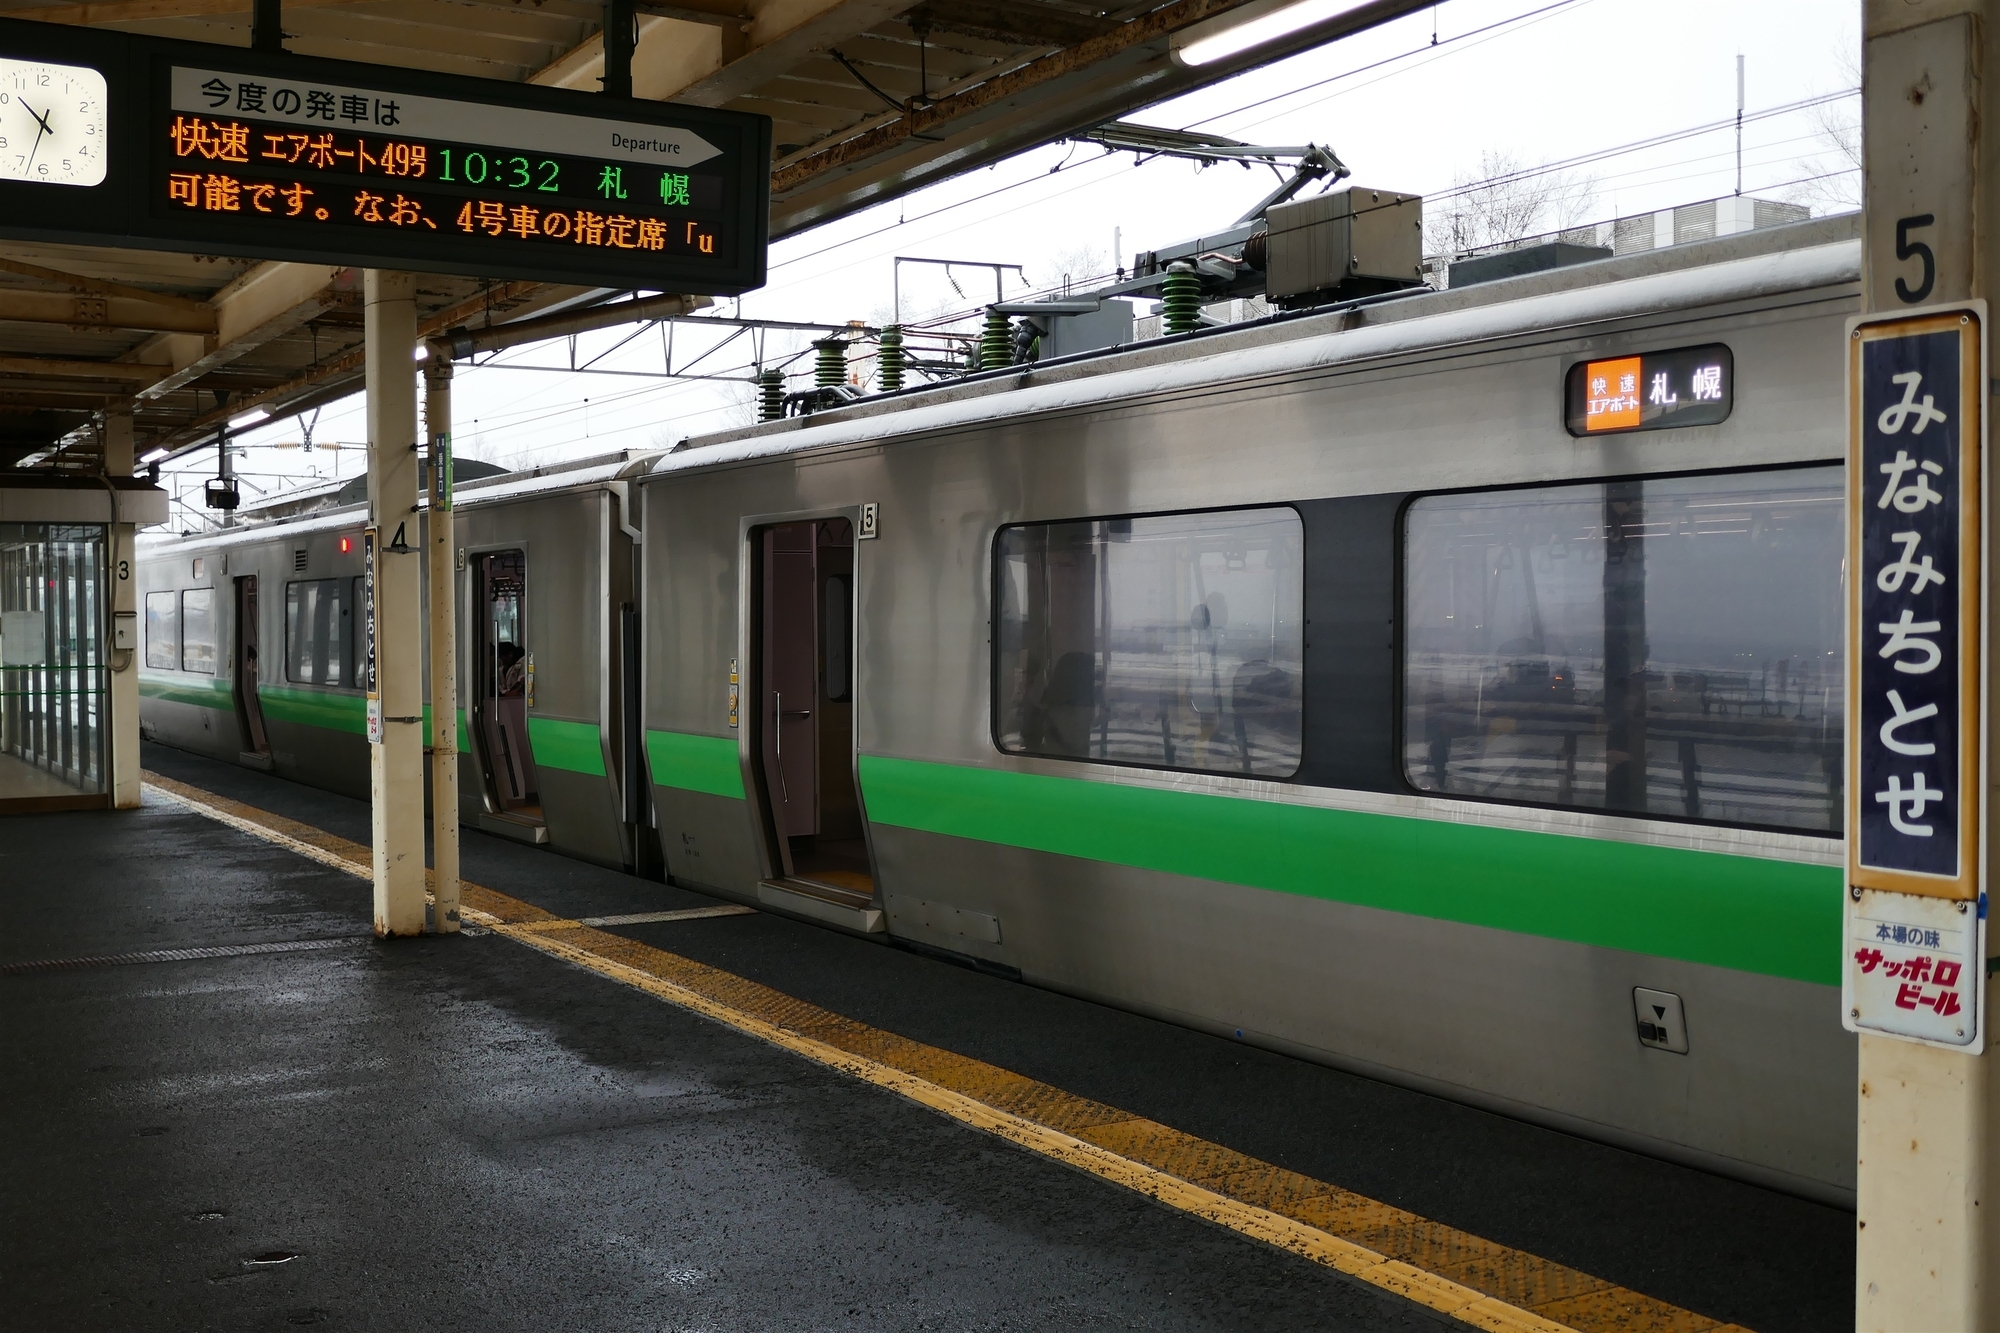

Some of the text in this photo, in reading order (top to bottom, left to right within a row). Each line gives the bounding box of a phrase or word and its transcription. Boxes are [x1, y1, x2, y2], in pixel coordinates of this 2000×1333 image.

[15, 77, 25, 90] 11
[37, 74, 50, 87] 12
[79, 101, 89, 113] 2
[201, 77, 401, 127] 今度の発車は
[85, 123, 96, 136] 3
[78, 145, 88, 157] 4
[170, 116, 250, 163] 快速
[261, 132, 427, 178] エアポート49号
[438, 149, 560, 193] 10:32
[611, 132, 681, 155] Departure
[15, 154, 26, 167] 7
[37, 163, 49, 175] 6
[62, 159, 72, 171] 5
[1894, 213, 1935, 304] 5
[1591, 373, 1636, 397] 快速
[1587, 395, 1640, 416] エアポート
[865, 506, 873, 528] 5
[118, 560, 129, 580] 3
[366, 544, 376, 683] みなみちとせ
[1874, 370, 1948, 838] みなみちとせ
[1875, 922, 1941, 950] 本場の味
[1854, 946, 1963, 988] サッポロ
[1894, 982, 1962, 1017] ビール
